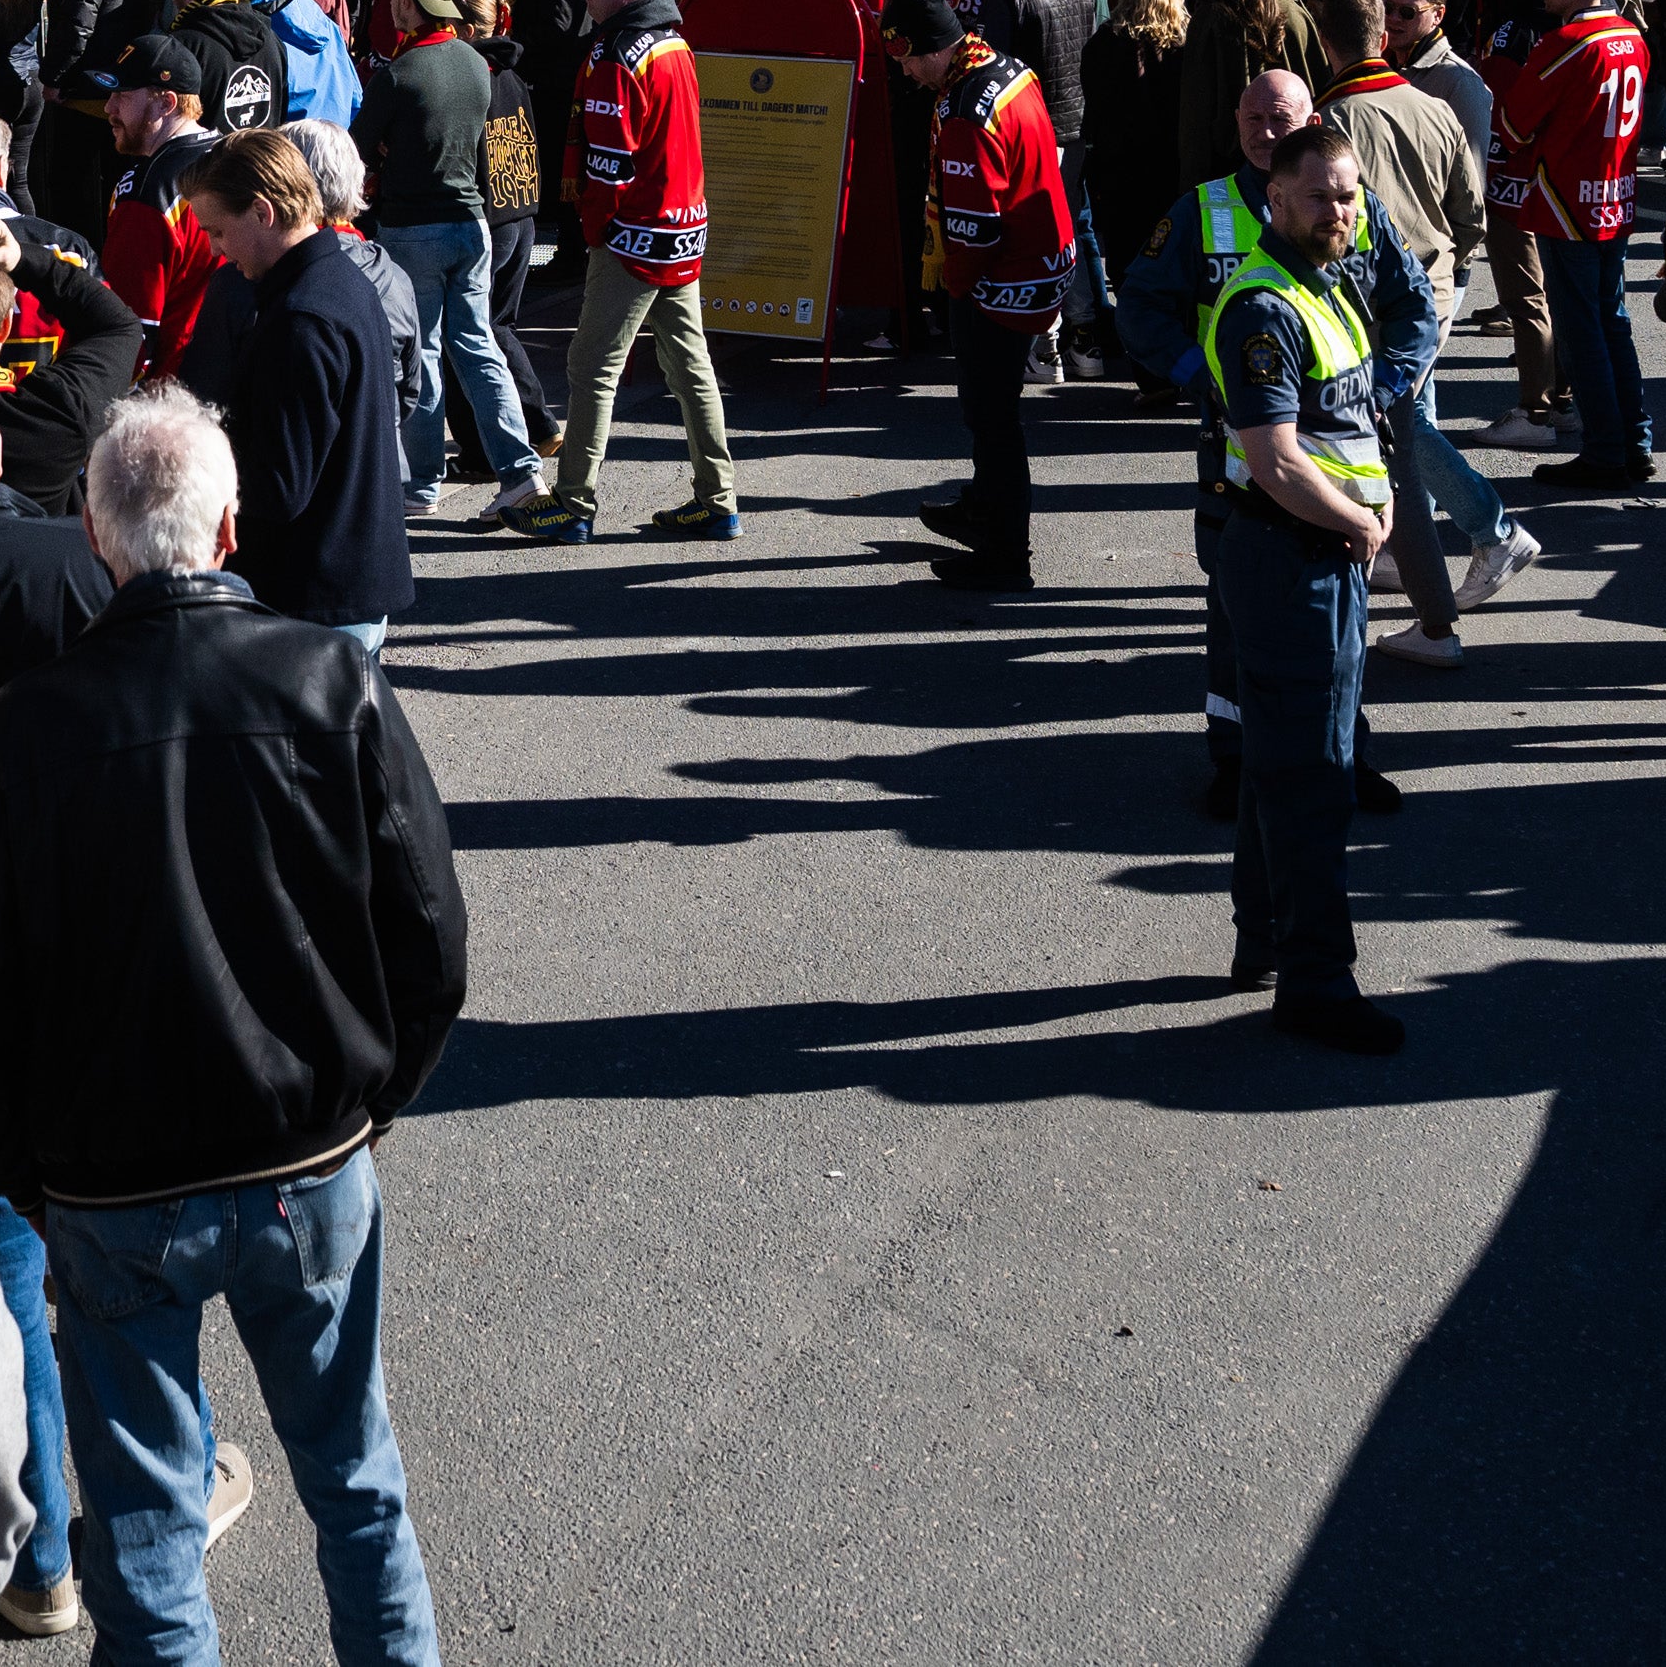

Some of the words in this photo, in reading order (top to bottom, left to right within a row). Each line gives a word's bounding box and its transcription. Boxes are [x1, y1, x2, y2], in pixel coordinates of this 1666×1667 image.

[1606, 39, 1635, 57] SSAB
[699, 98, 740, 111] LKOMMEN
[742, 100, 760, 112] TILL
[761, 102, 794, 114] DAGENS
[795, 104, 829, 117] MATCH!
[1599, 65, 1644, 138] 19
[485, 106, 535, 143] LULEÅ
[486, 138, 538, 175] HOCKEY
[489, 172, 539, 208] 1977
[947, 217, 979, 237] KAB
[1589, 202, 1634, 229] SSAB
